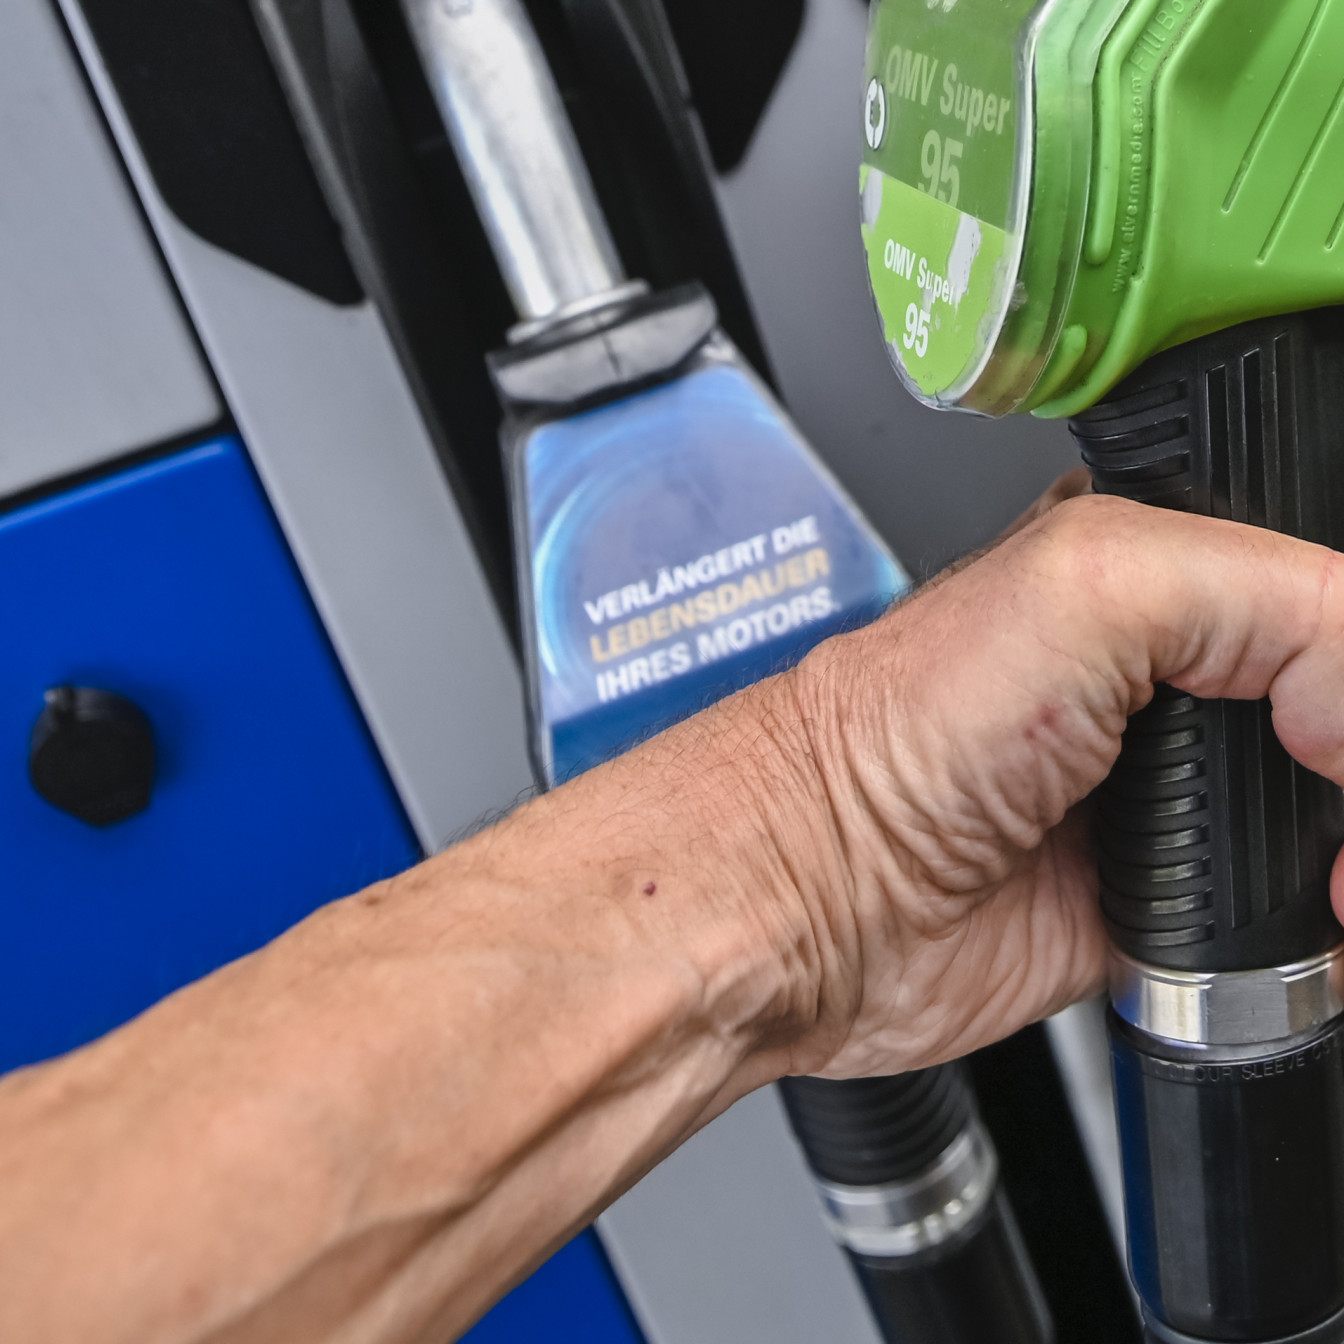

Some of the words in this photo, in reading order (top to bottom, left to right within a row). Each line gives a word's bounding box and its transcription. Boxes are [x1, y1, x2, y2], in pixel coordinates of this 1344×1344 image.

[885, 45, 938, 106] OMV
[940, 63, 1010, 136] Super
[918, 129, 963, 207] 95
[884, 239, 916, 280] OMV
[903, 303, 931, 357] 95
[583, 532, 767, 626] VERLÄNGERT
[770, 514, 821, 555] DIE
[590, 548, 832, 663] LEBENSDAUER
[597, 644, 692, 703] IHRES
[1242, 1052, 1306, 1080] SLEEVE
